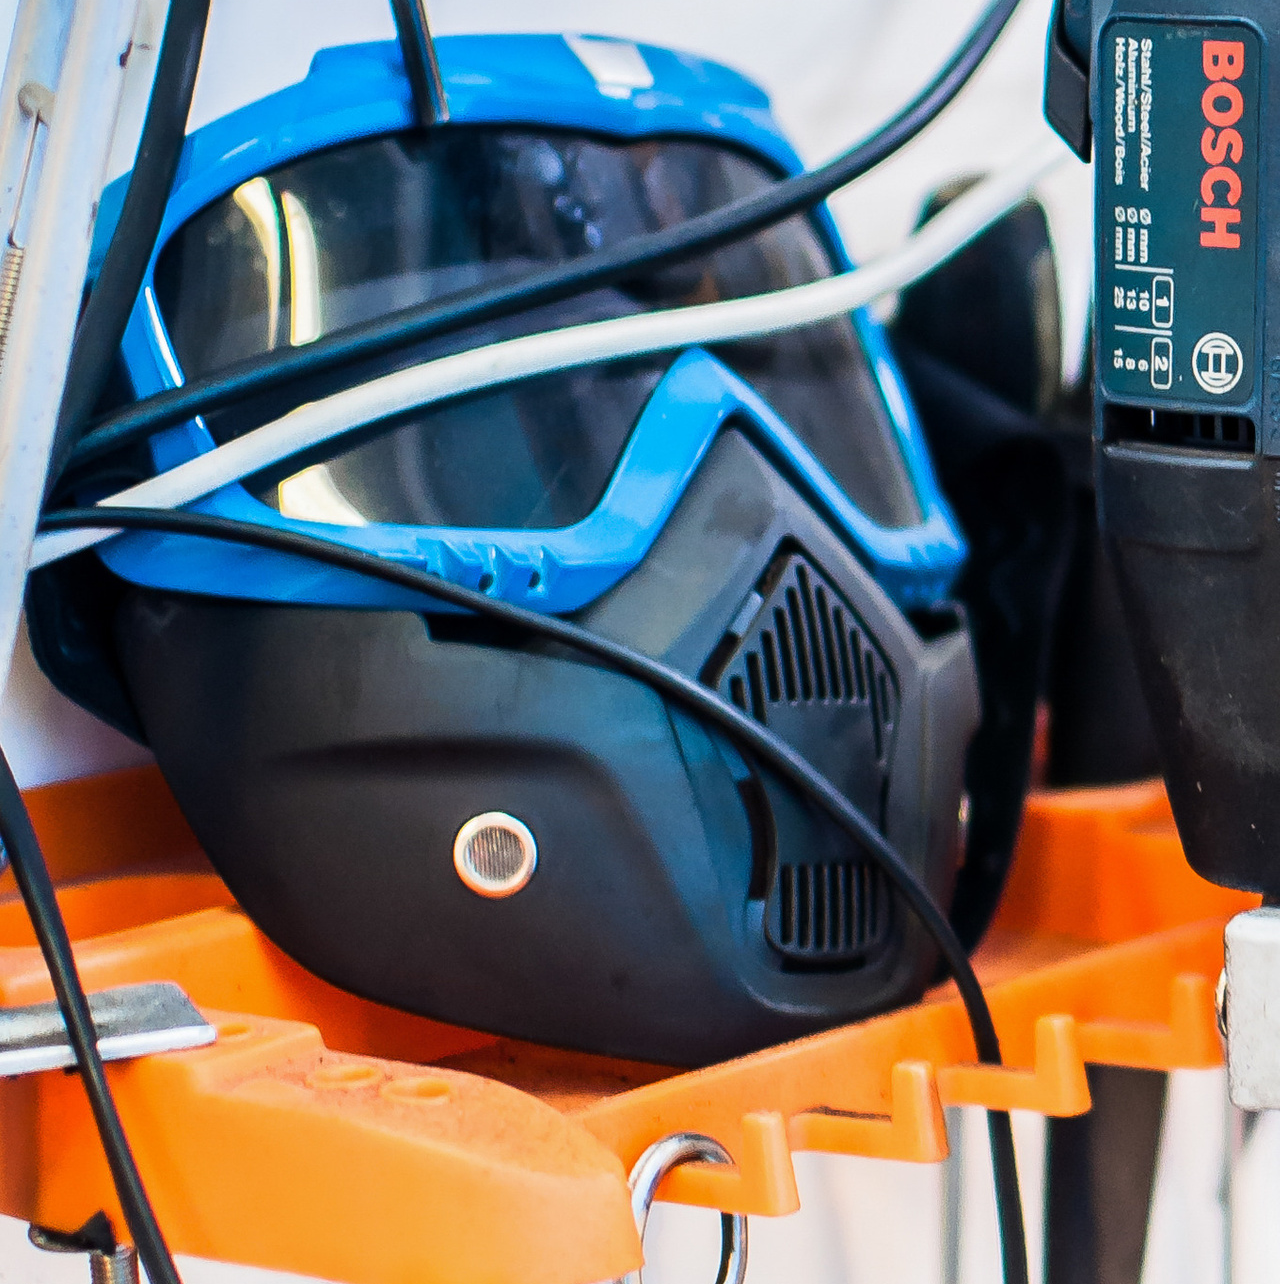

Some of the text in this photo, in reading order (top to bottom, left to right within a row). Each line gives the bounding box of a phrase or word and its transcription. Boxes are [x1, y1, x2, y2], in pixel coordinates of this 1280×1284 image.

[1128, 37, 1138, 133] Aluminium
[1115, 37, 1125, 185] Holz/Wood/Bois
[1140, 38, 1152, 192] Stahl/Steel/Acier
[1200, 40, 1244, 249] BOSCH
[1115, 226, 1123, 261] mm
[1127, 227, 1135, 262] mm
[1139, 228, 1148, 263] mm
[1114, 286, 1124, 308] 25
[1126, 289, 1136, 310] 13
[1139, 290, 1149, 311] 10
[1155, 296, 1169, 371] 1 2
[1113, 347, 1123, 369] 15
